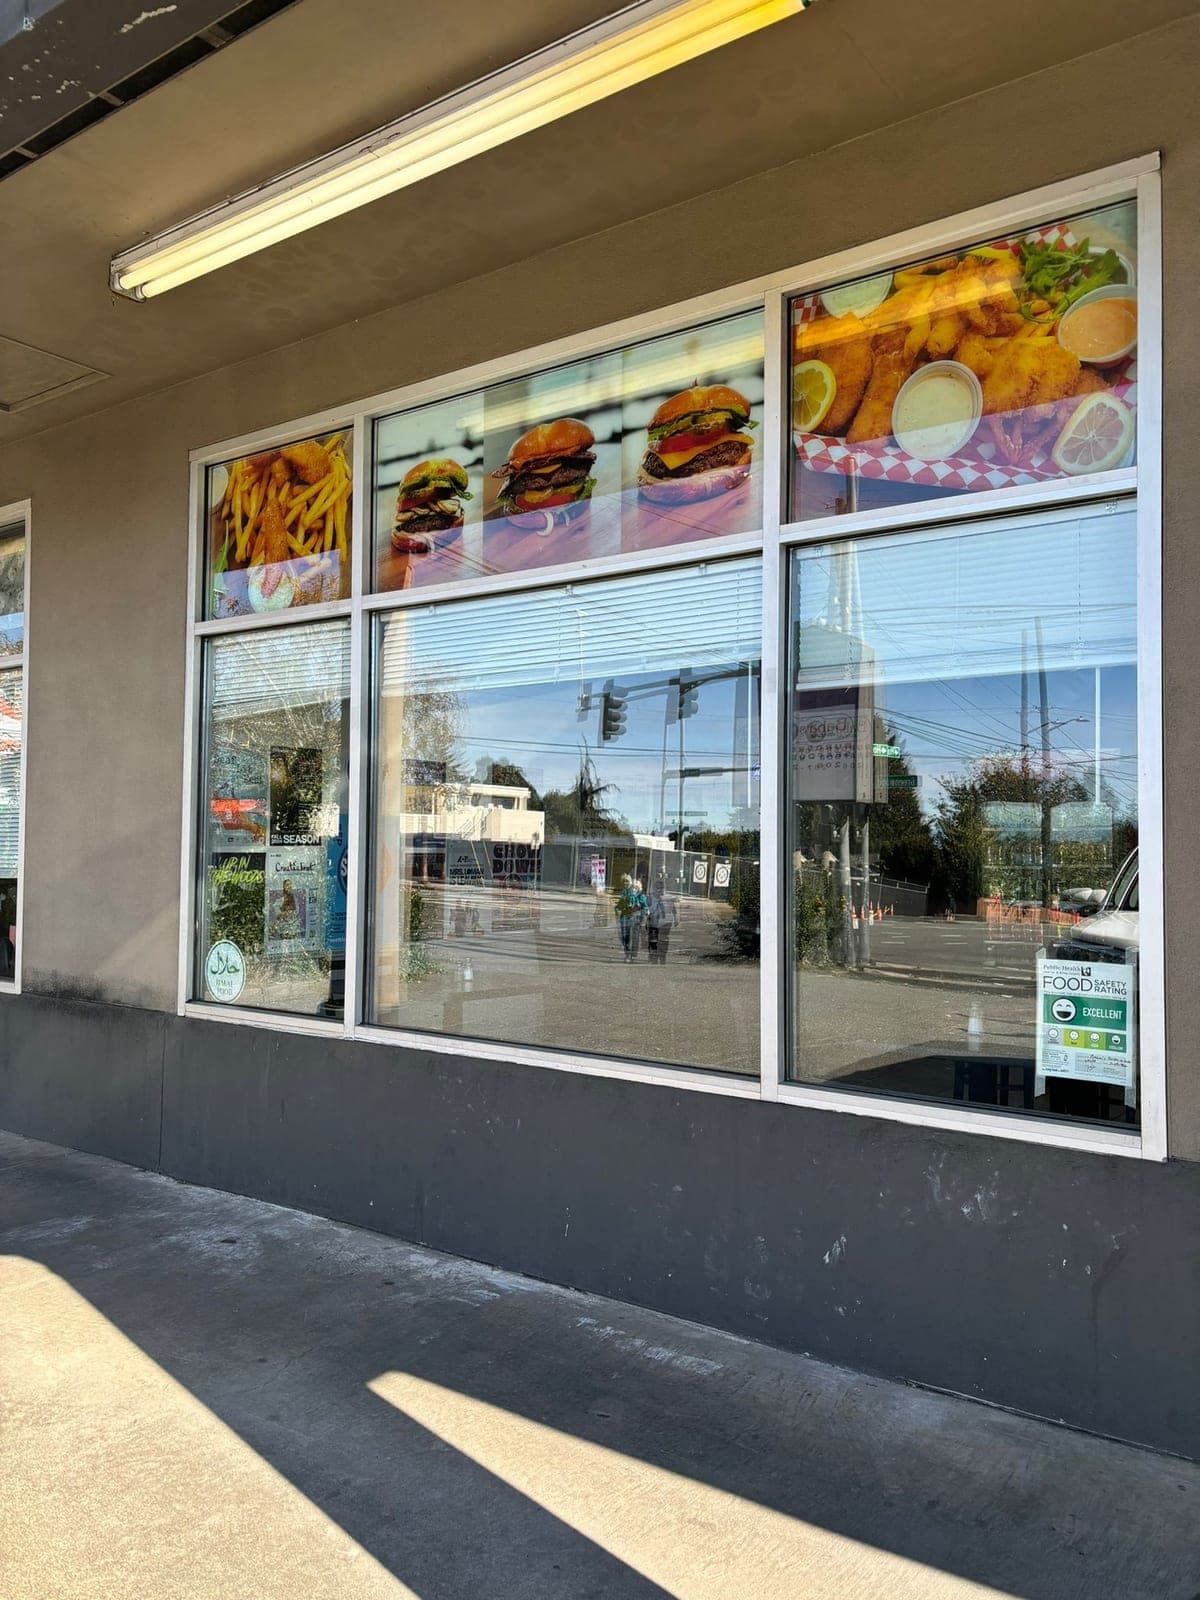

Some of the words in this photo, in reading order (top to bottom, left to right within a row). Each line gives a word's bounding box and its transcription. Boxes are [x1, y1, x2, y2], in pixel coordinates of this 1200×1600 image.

[283, 834, 319, 843] SEASON
[239, 855, 251, 870] IN
[231, 870, 264, 884] WOODS
[211, 951, 240, 975] حلال
[1043, 976, 1092, 991] FOOD
[1094, 980, 1126, 988] SAFETY
[1094, 986, 1127, 995] RATING
[1082, 1007, 1122, 1020] EXCELLENT
